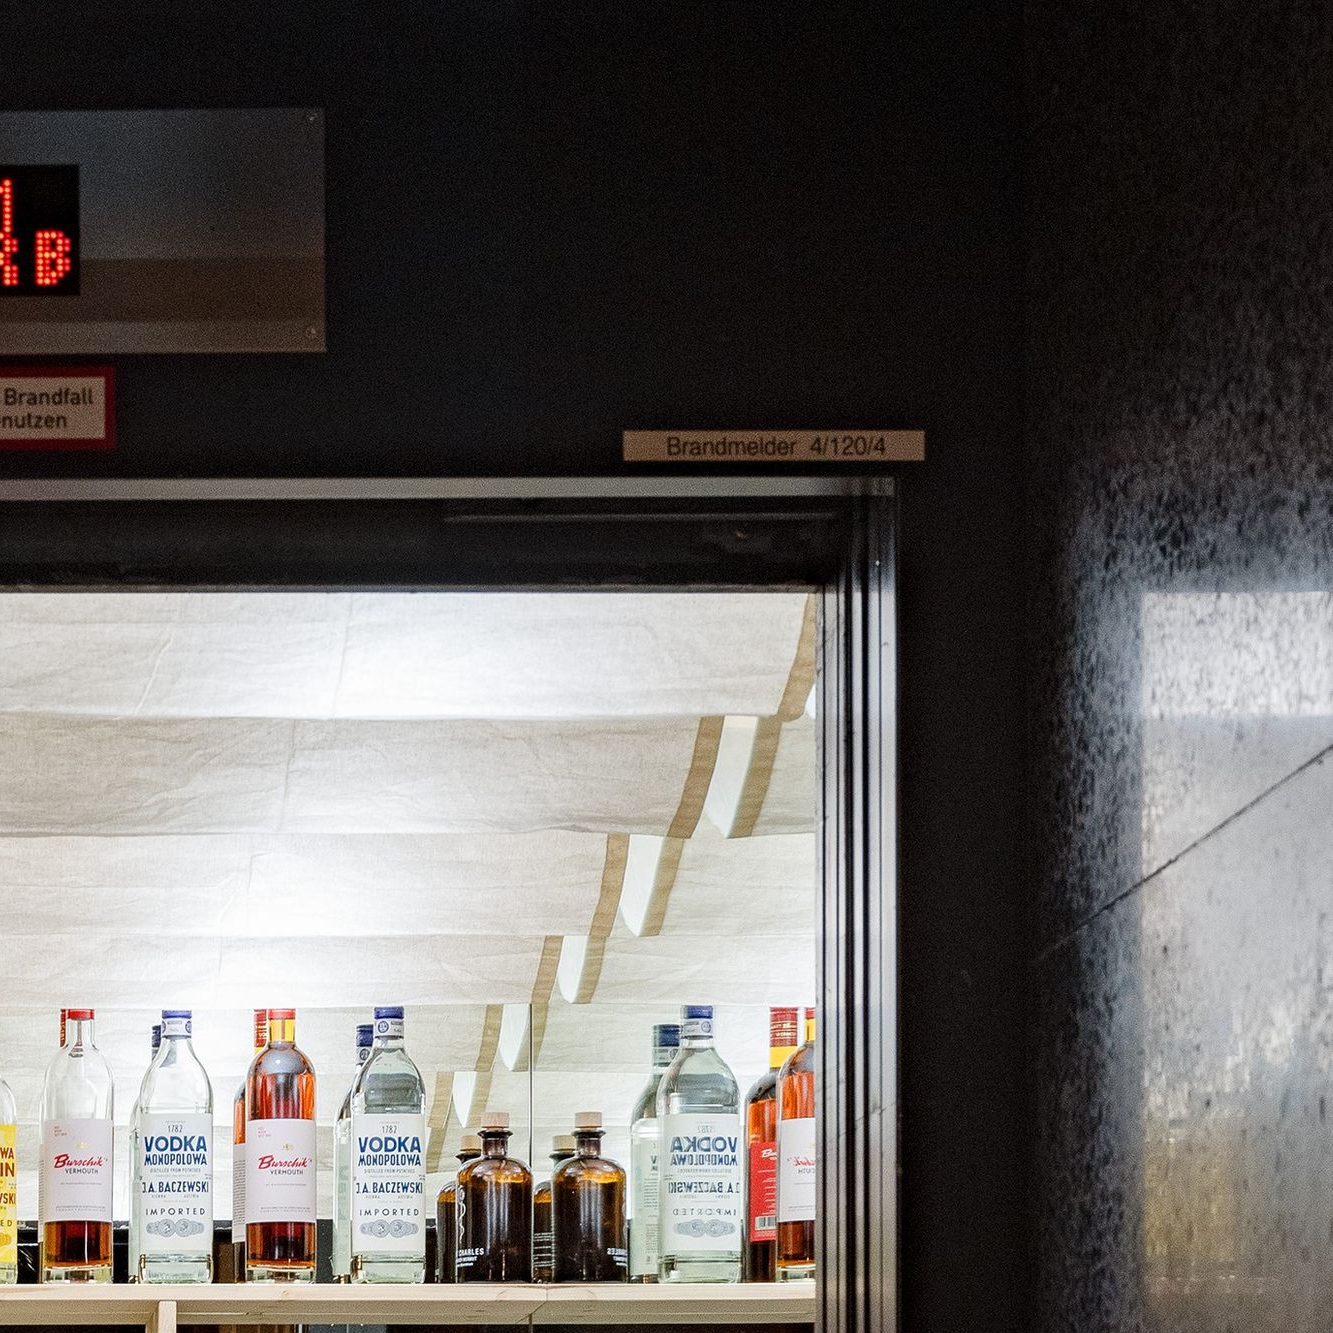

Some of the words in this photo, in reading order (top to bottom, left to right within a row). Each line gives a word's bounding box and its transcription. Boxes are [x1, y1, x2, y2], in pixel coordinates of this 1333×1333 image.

[35, 230, 72, 286] B
[4, 388, 93, 406] Brandfall
[667, 436, 796, 455] Brandmelder
[809, 436, 885, 455] 4/120/4
[168, 1125, 183, 1133] 1782
[382, 1125, 397, 1133] 1782
[144, 1136, 207, 1152] VODKA
[358, 1136, 421, 1153] VODKA
[144, 1153, 208, 1166] MONOPOLOWA
[358, 1154, 421, 1166] MONOPOLOWA
[158, 1181, 209, 1193] BACZEWSKI
[372, 1182, 423, 1194] BACZEWSKI
[359, 1208, 419, 1216] IMPORTED
